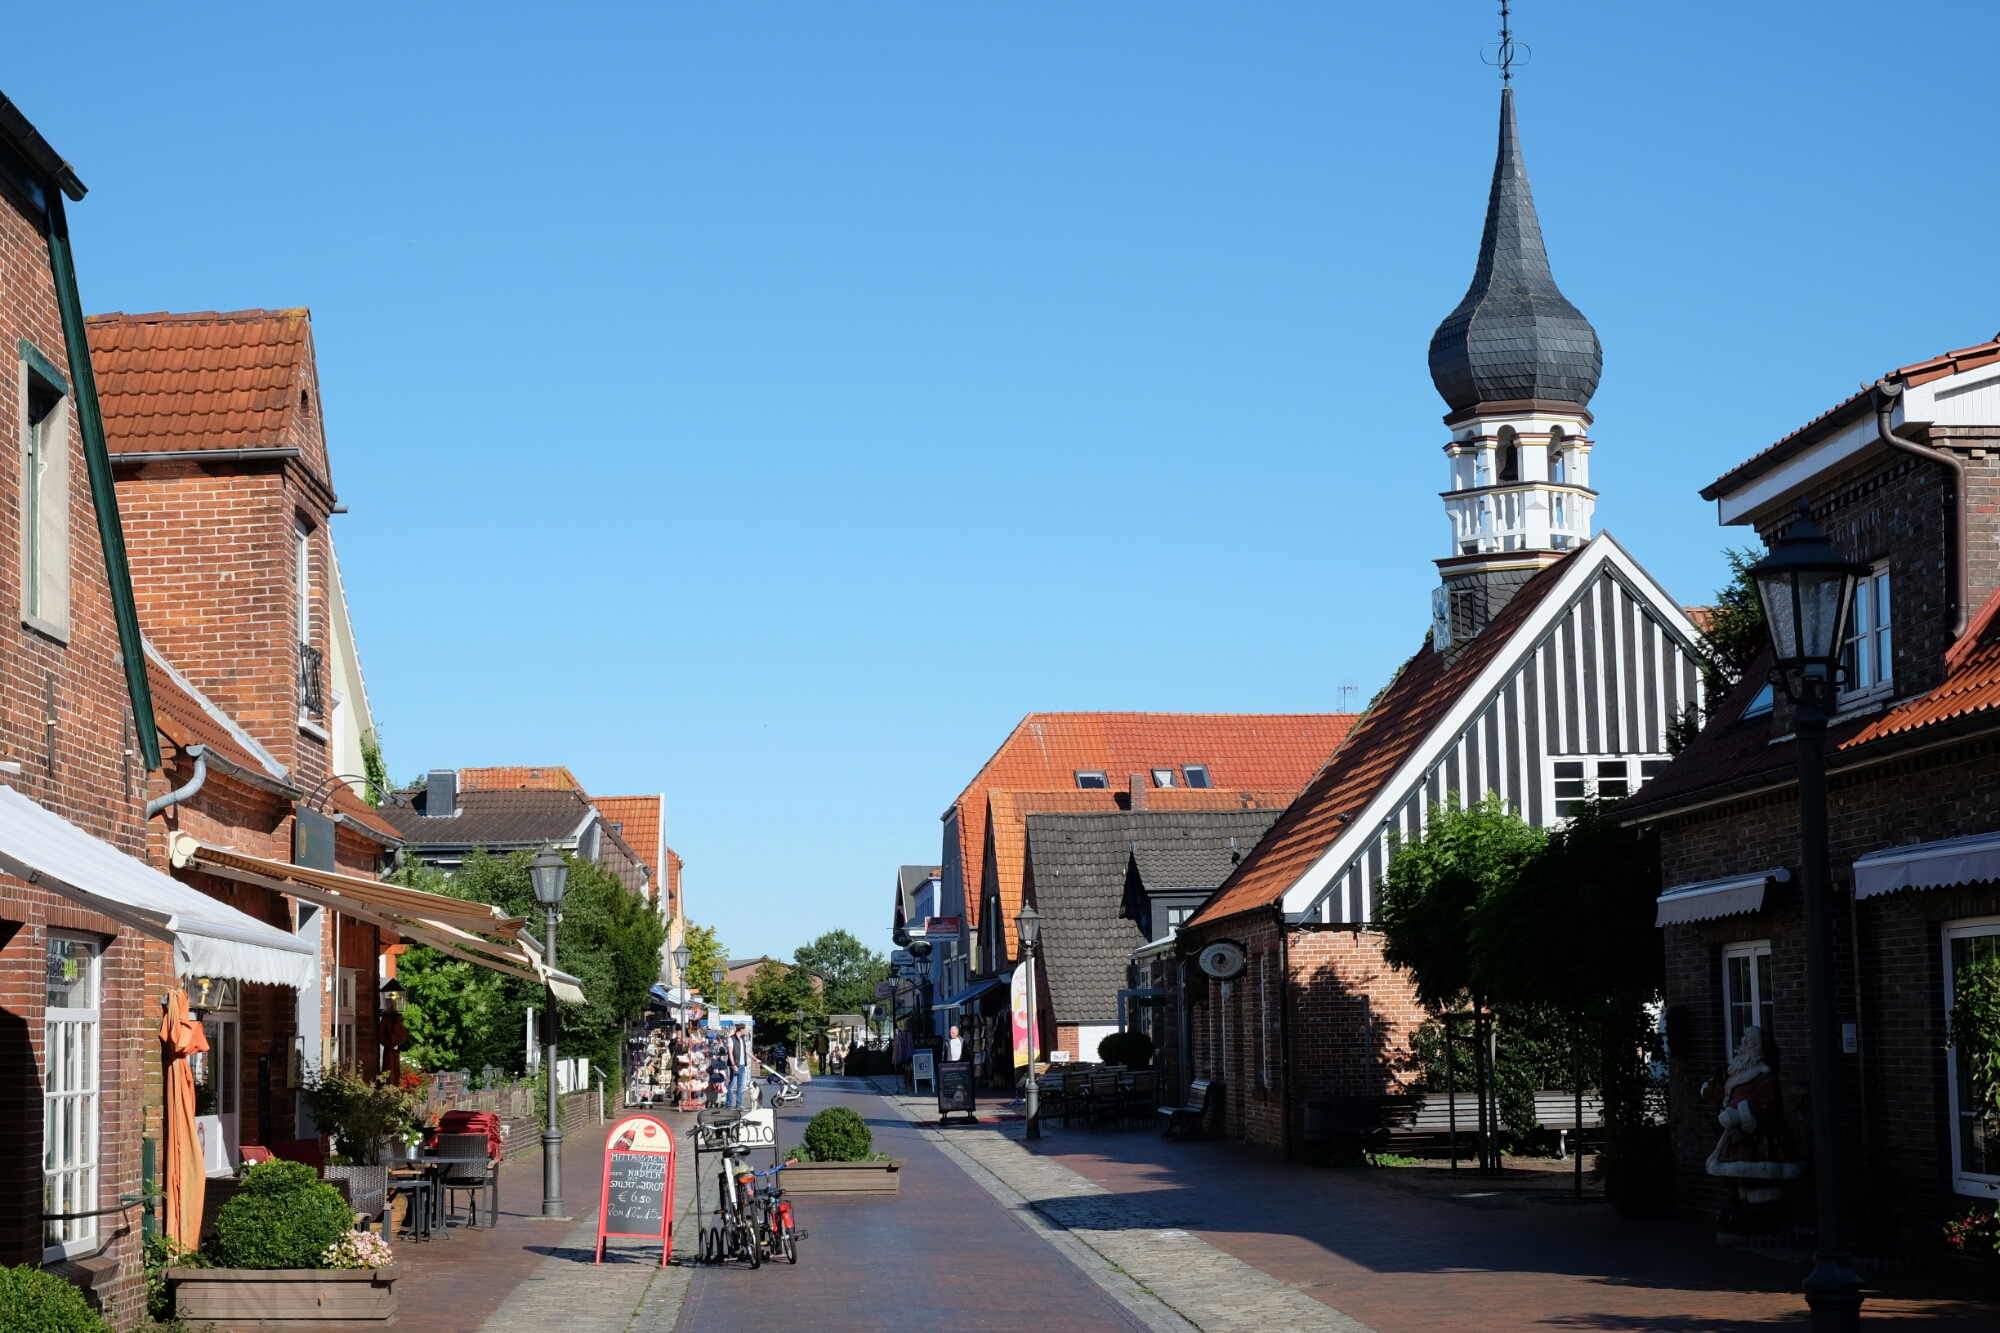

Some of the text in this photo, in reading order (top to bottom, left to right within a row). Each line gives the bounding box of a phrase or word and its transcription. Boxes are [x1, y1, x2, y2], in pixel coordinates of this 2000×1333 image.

[64, 958, 78, 979] BAG
[640, 1162, 667, 1173] PIZZA
[628, 1169, 661, 1180] NUDELN
[610, 1180, 636, 1188] SALAT
[641, 1181, 665, 1191] BROT
[617, 1190, 629, 1203] €
